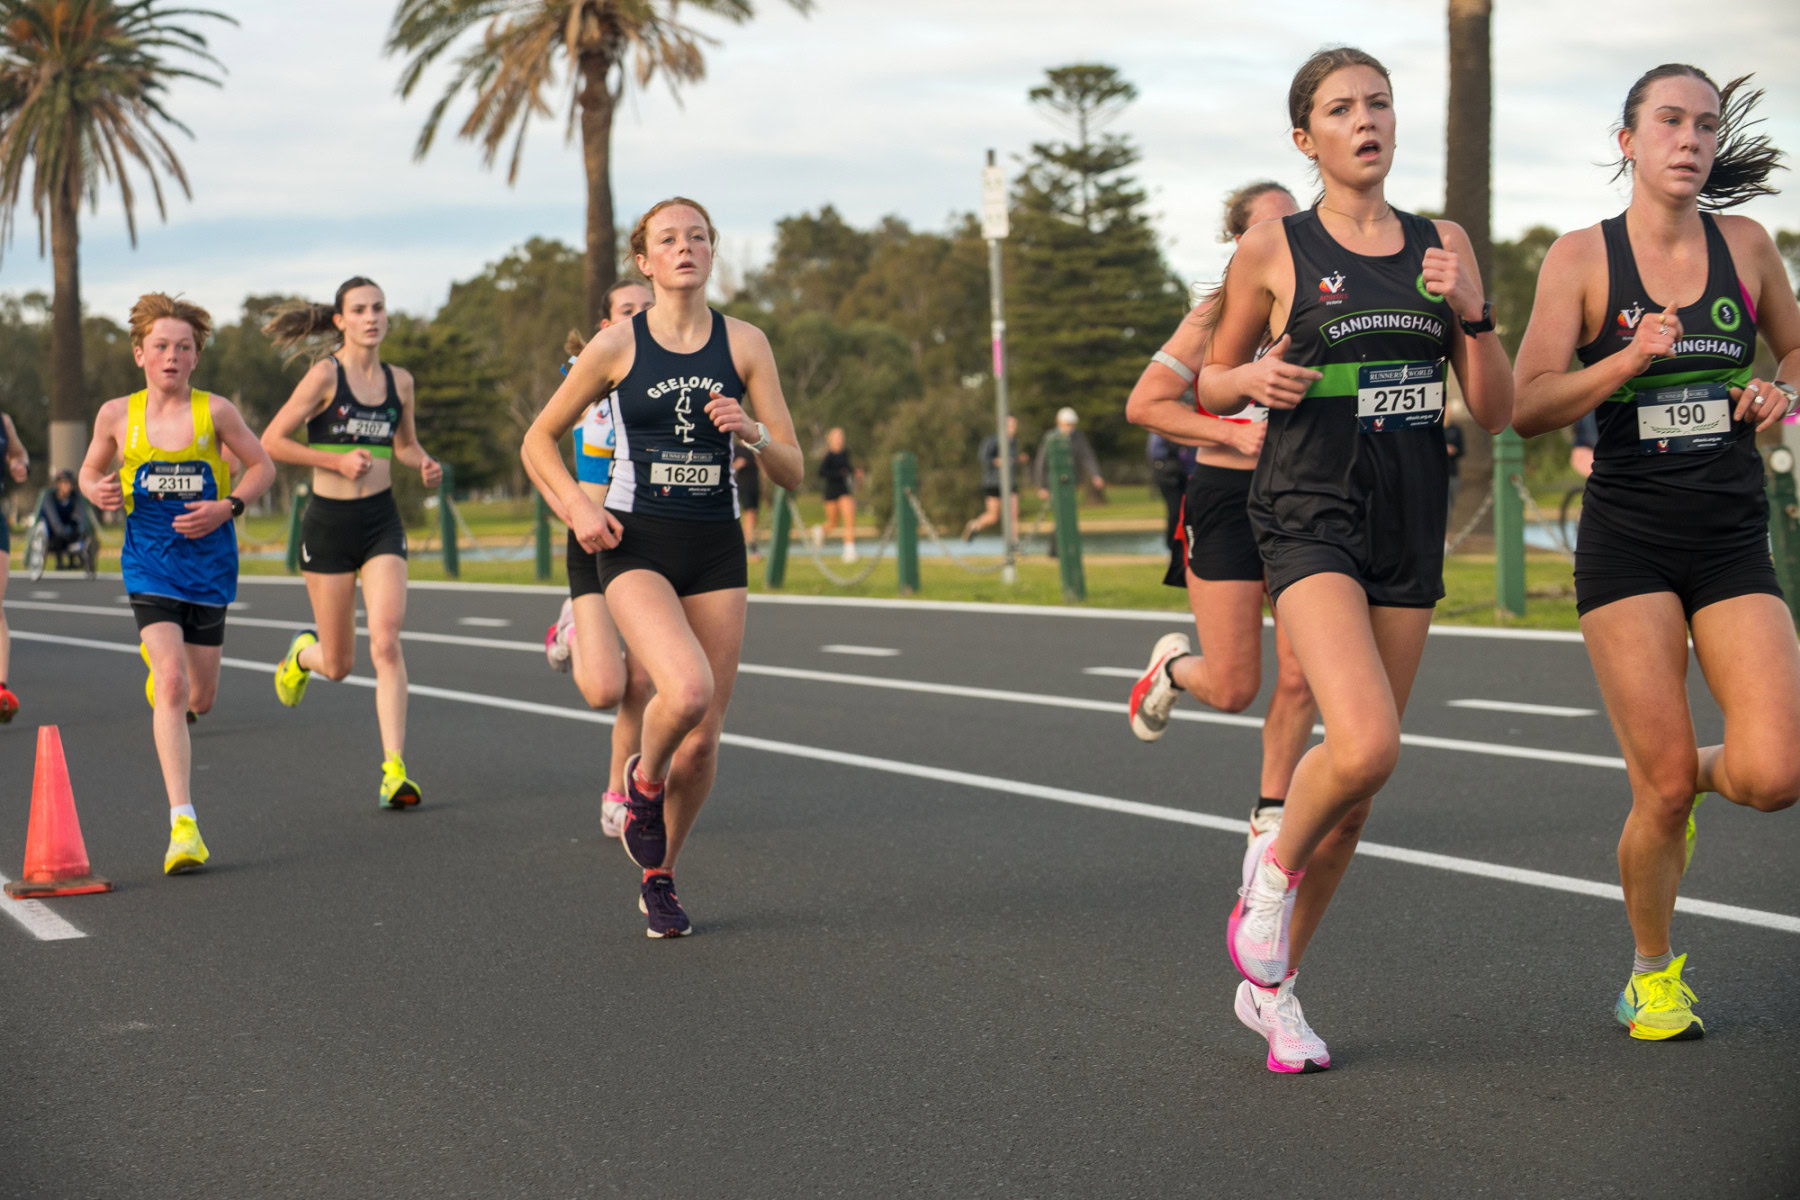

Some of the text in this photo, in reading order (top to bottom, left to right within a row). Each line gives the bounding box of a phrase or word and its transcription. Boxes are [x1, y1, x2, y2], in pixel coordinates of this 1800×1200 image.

[1328, 314, 1443, 340] SANDRINGHAM
[1671, 339, 1742, 358] RINGHAM
[1408, 368, 1434, 377] WORLD
[647, 376, 724, 399] GEELONG
[1374, 386, 1426, 412] 2751
[1665, 403, 1706, 426] 190
[355, 421, 383, 435] 2107
[158, 477, 191, 490] 2311
[665, 466, 708, 483] 1620
